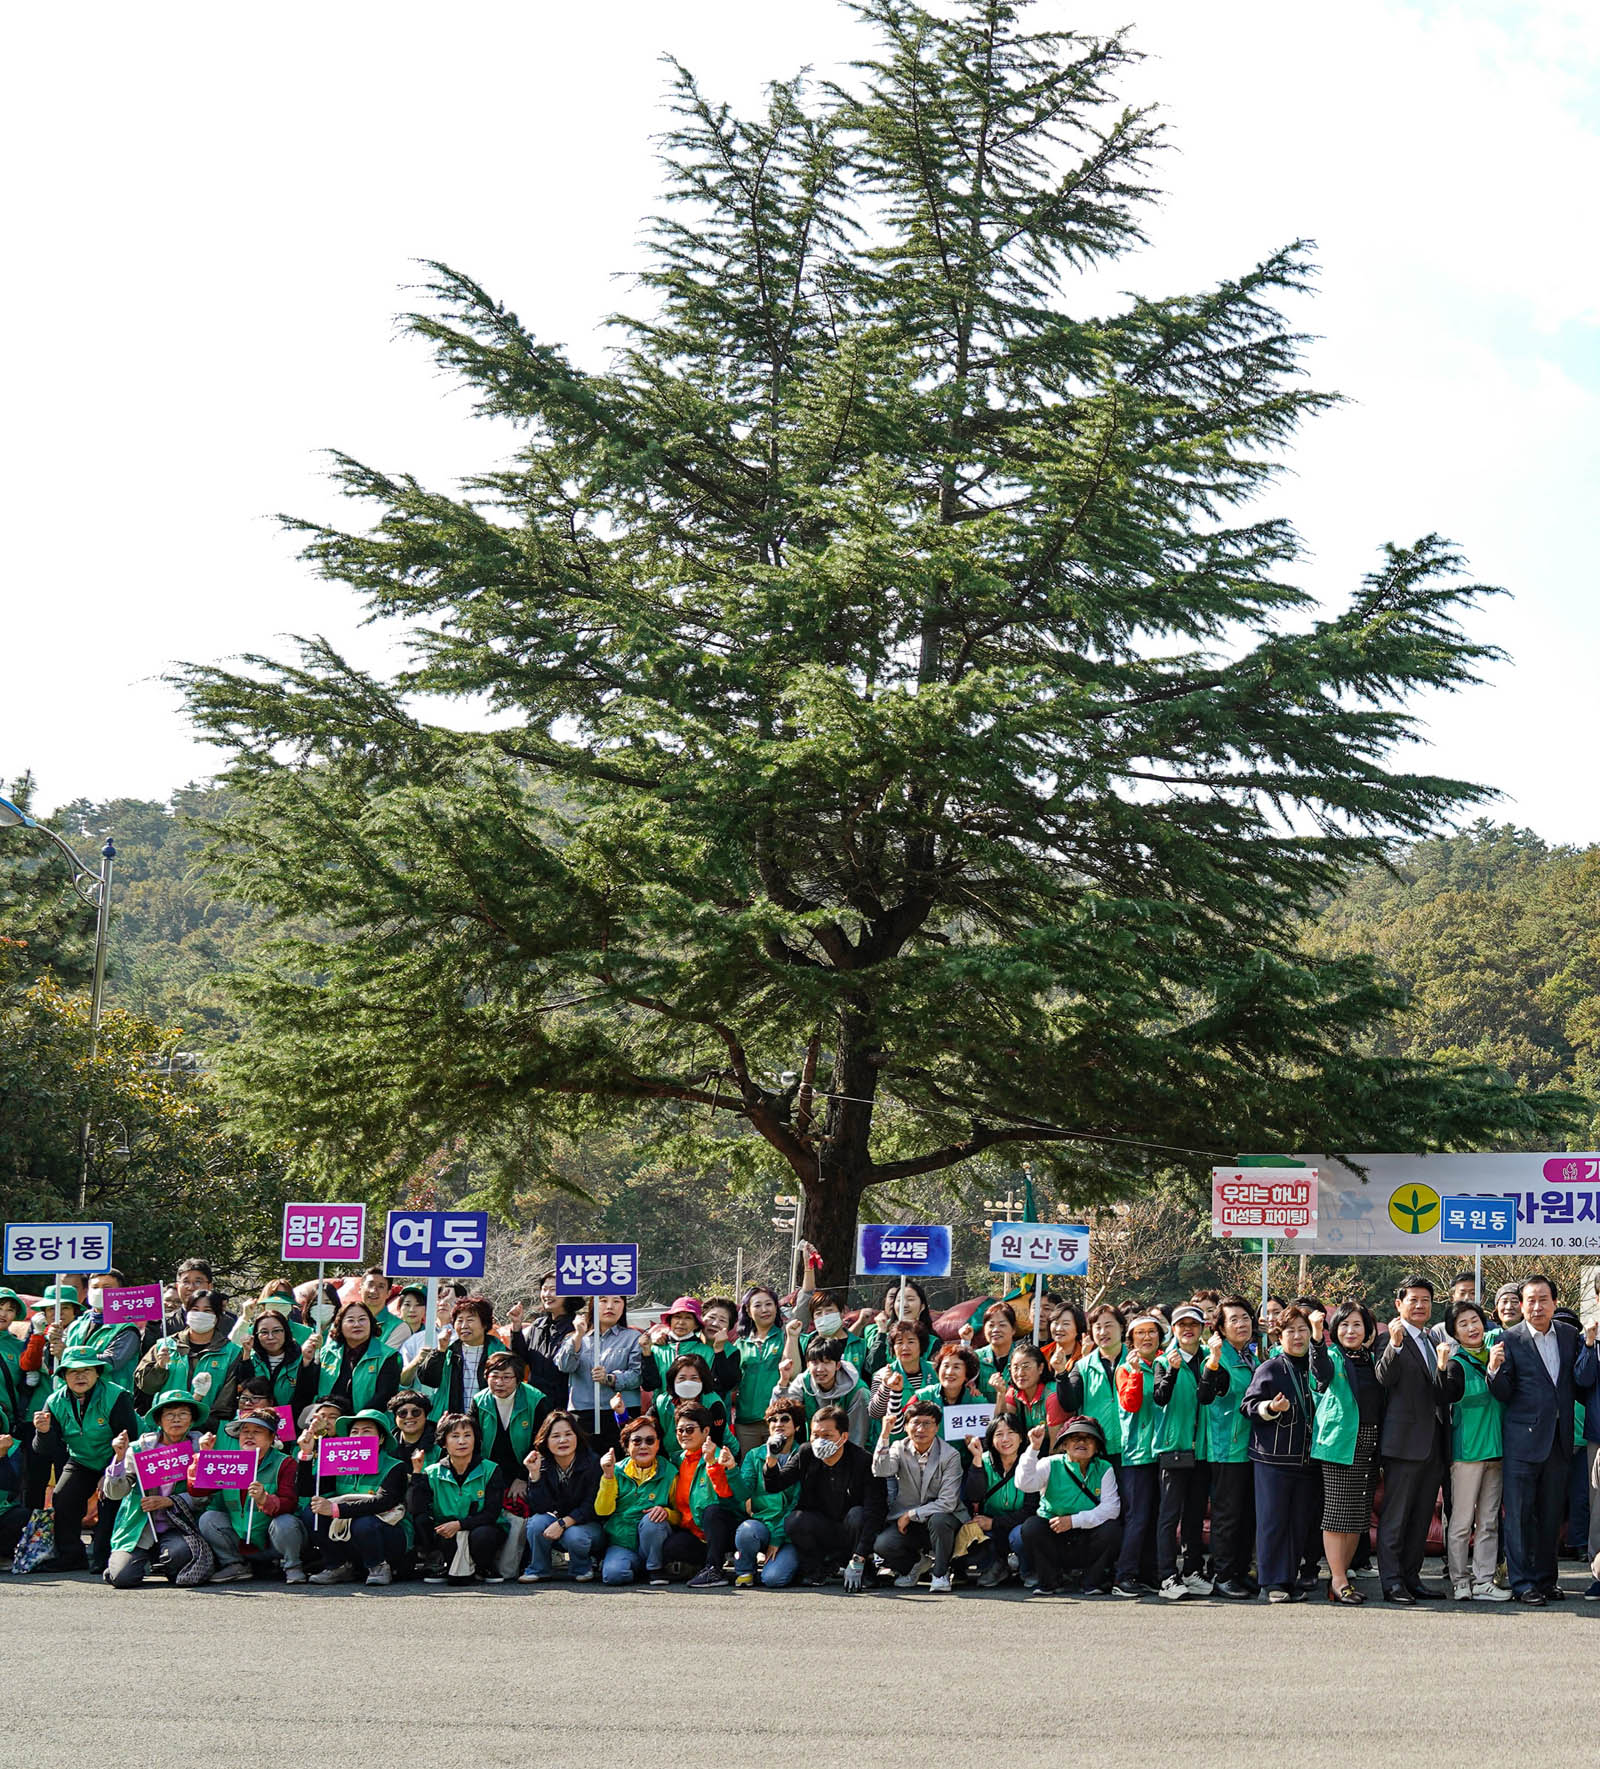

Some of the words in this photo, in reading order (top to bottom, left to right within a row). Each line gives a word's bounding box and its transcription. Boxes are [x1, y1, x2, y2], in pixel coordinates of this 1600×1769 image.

[1222, 1185, 1270, 1203] 우리는
[1272, 1185, 1308, 1204] 하나!
[1222, 1208, 1263, 1224] 대성동
[1264, 1208, 1308, 1225] 파이팅!
[1447, 1209, 1509, 1232] 목원동
[287, 1215, 326, 1248] 용당
[328, 1215, 359, 1248] 2동
[12, 1235, 105, 1262] 용당1동
[391, 1218, 483, 1271] 연동
[880, 1241, 929, 1260] 연산동
[1000, 1234, 1080, 1263] 원산동
[1518, 1237, 1548, 1248] 2024.
[1550, 1236, 1567, 1248] 10.
[558, 1253, 634, 1286] 산정동
[109, 1295, 156, 1312] 용당2동
[951, 1414, 991, 1429] 원산동
[144, 1453, 191, 1475] 용당2동
[324, 1448, 372, 1463] 용당2동
[203, 1462, 249, 1476] 용당2동
